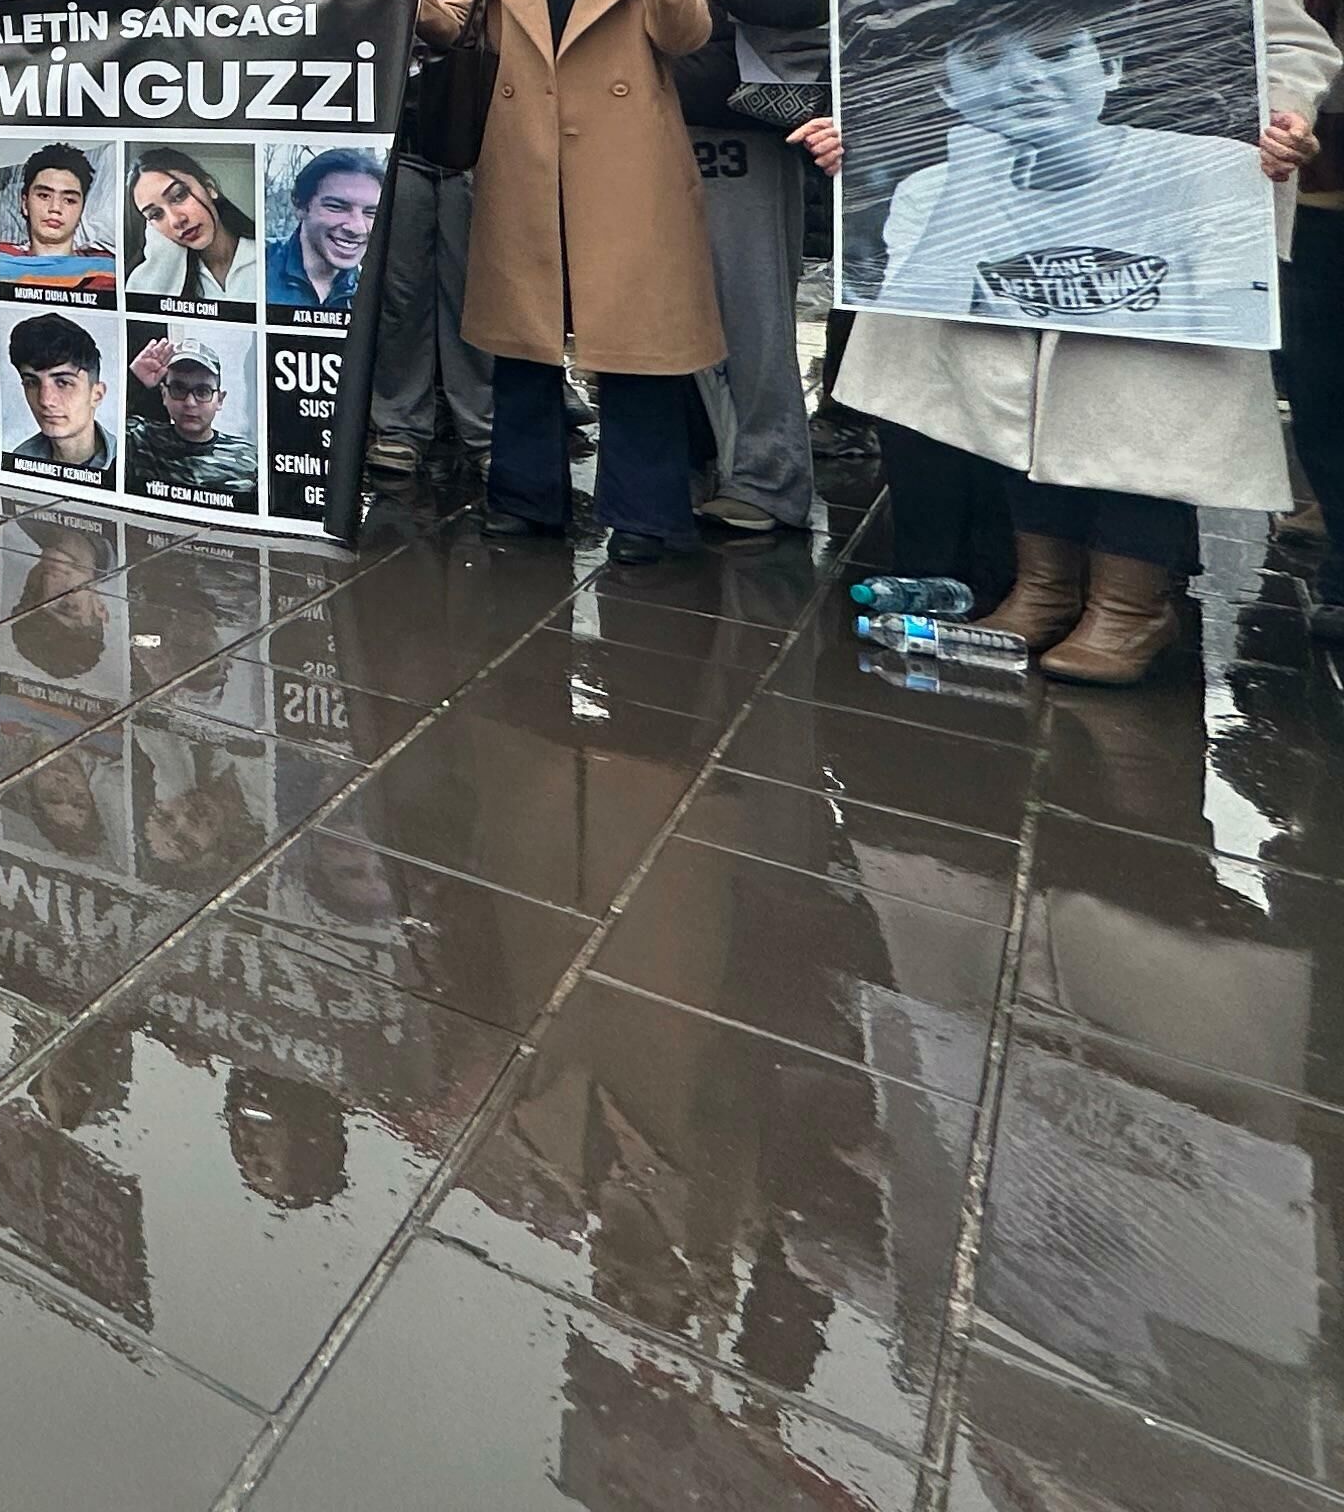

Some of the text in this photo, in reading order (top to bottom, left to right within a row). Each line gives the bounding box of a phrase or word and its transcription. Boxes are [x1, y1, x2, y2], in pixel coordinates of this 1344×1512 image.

[293, 309, 312, 323] ATA
[313, 311, 343, 325] EMRE
[274, 349, 343, 395] SUS
[274, 452, 321, 476] SENİN
[171, 485, 192, 501] CEM
